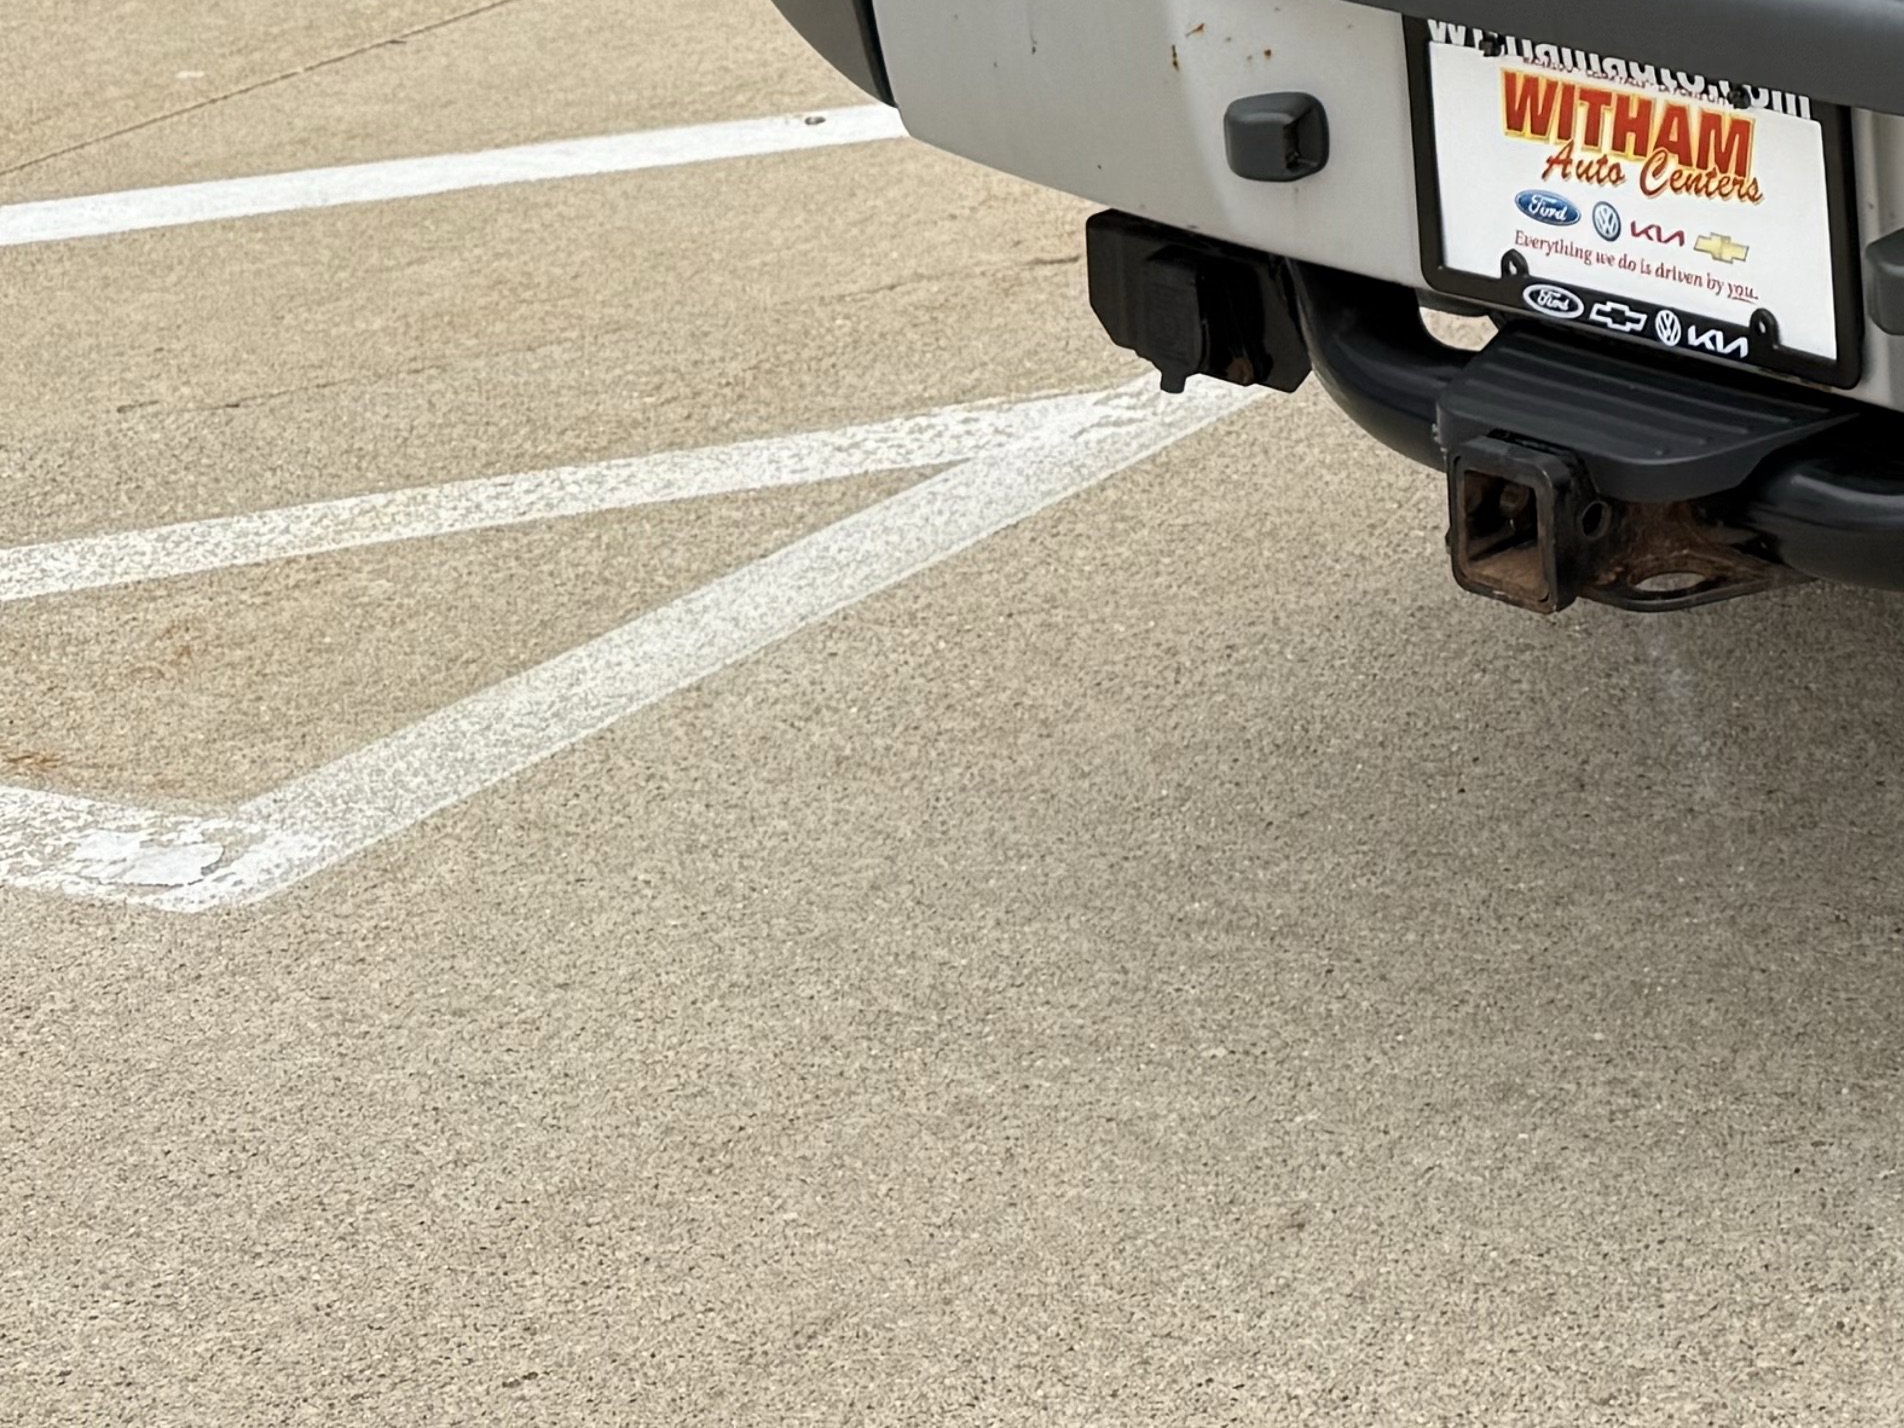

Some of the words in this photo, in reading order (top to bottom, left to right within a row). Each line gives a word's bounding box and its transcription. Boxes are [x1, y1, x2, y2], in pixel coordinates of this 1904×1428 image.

[1502, 70, 1755, 178] WITHAM
[1541, 141, 1626, 186] Auto
[1639, 148, 1764, 204] Centers
[1522, 192, 1573, 224] Ford
[1514, 229, 1592, 267] Everything
[1595, 249, 1615, 267] we
[1618, 253, 1637, 272] do
[1640, 258, 1652, 276] is
[1655, 263, 1704, 289] driven
[1707, 274, 1725, 298] by
[1531, 287, 1576, 315] Ford
